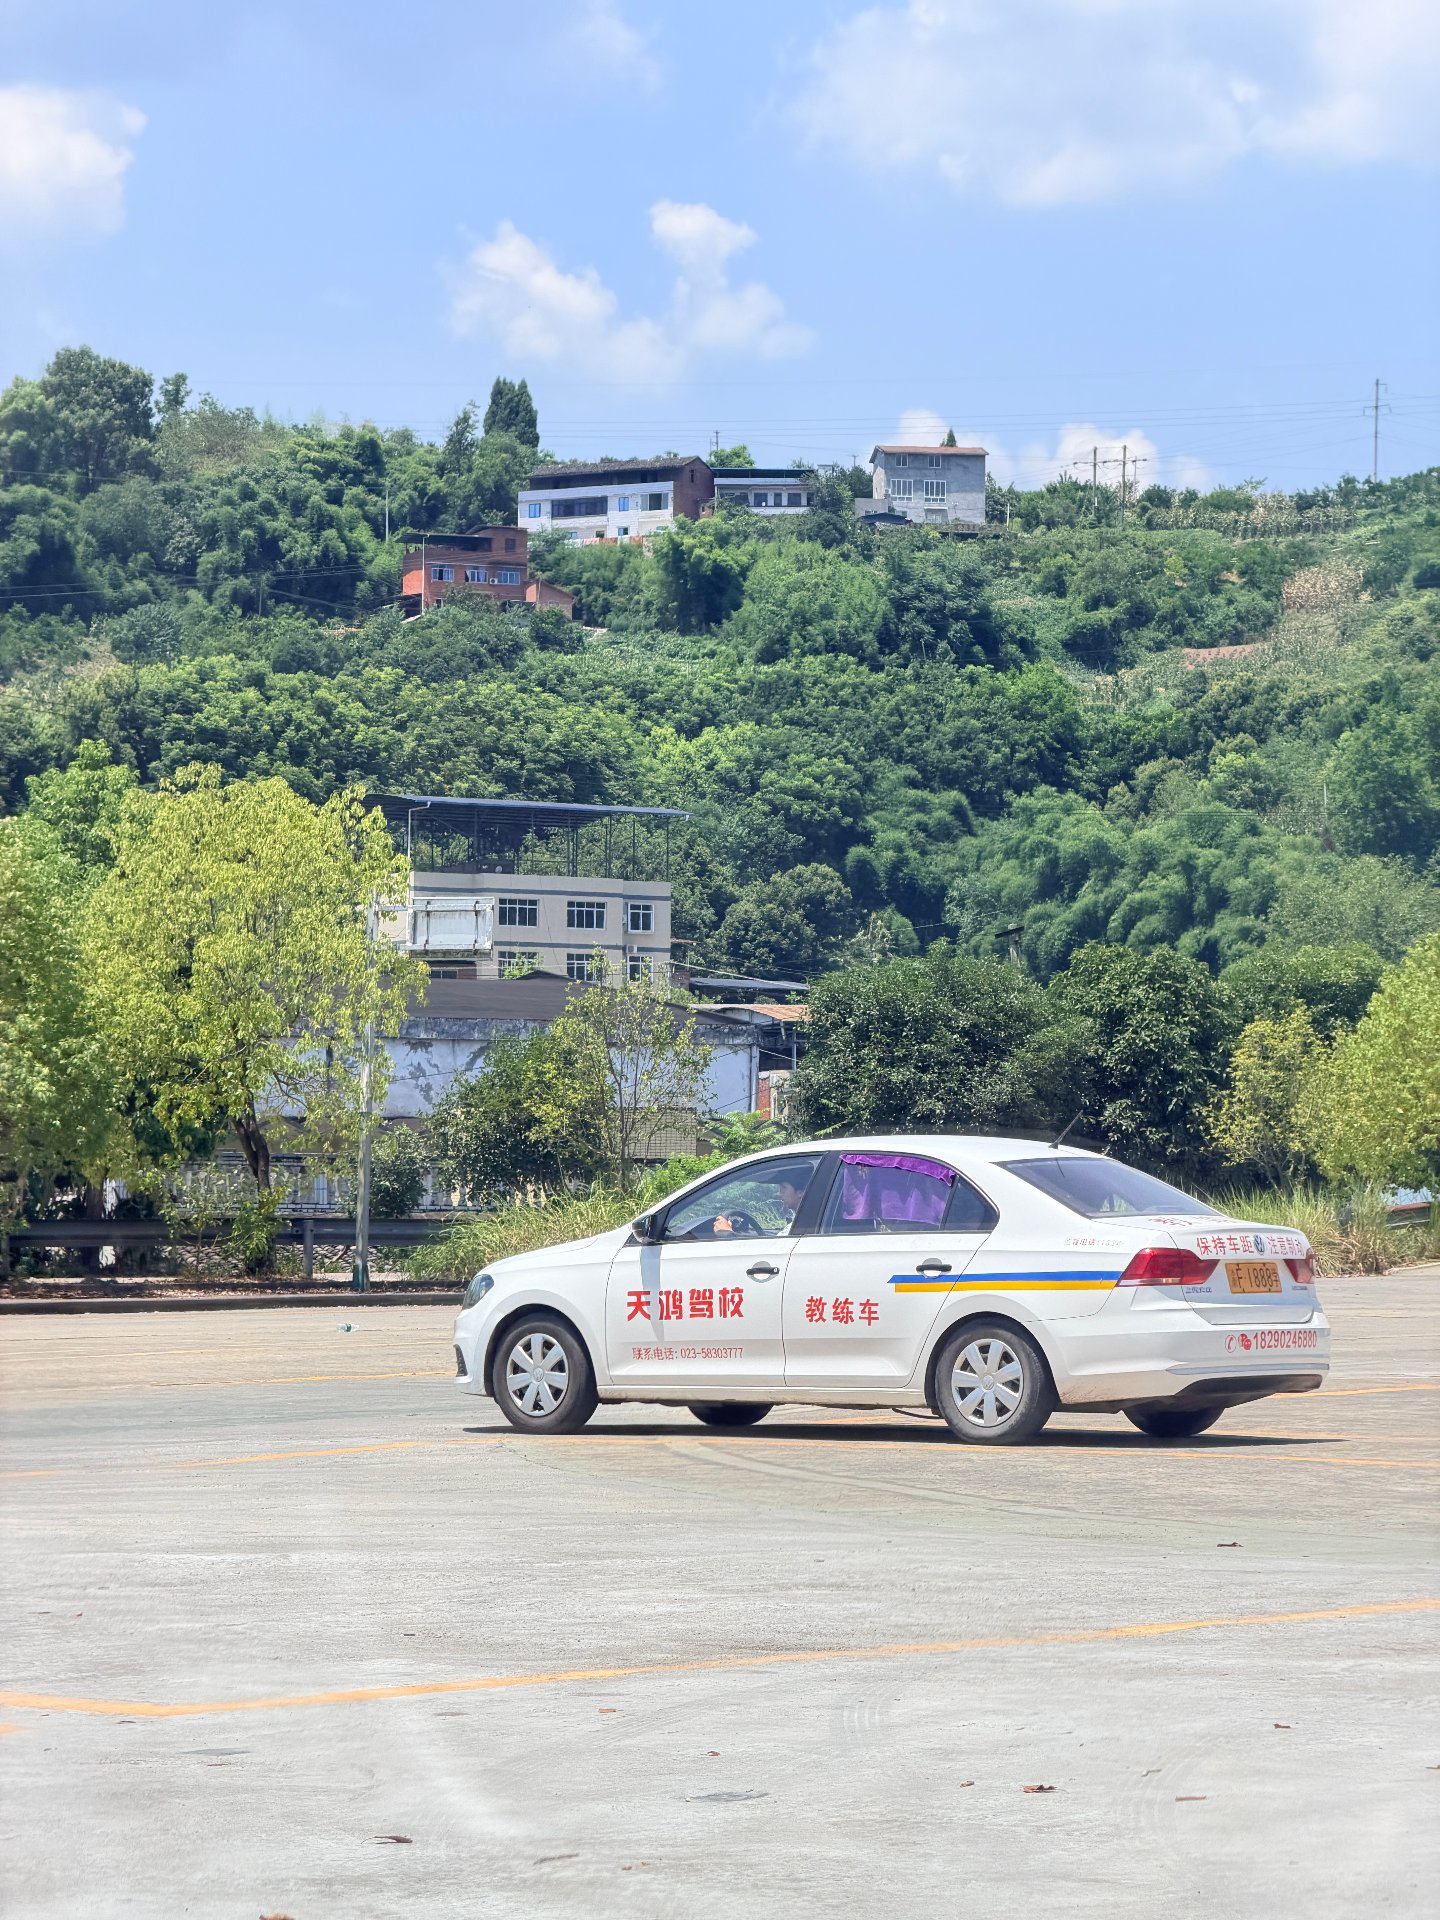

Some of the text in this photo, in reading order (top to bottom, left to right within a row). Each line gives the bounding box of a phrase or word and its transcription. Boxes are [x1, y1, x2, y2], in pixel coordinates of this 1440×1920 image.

[1196, 1235, 1254, 1256] 保持车距
[626, 1286, 745, 1322] 天鸿驾校
[804, 1295, 880, 1327] 教练车
[1253, 1330, 1318, 1351] 18290246880
